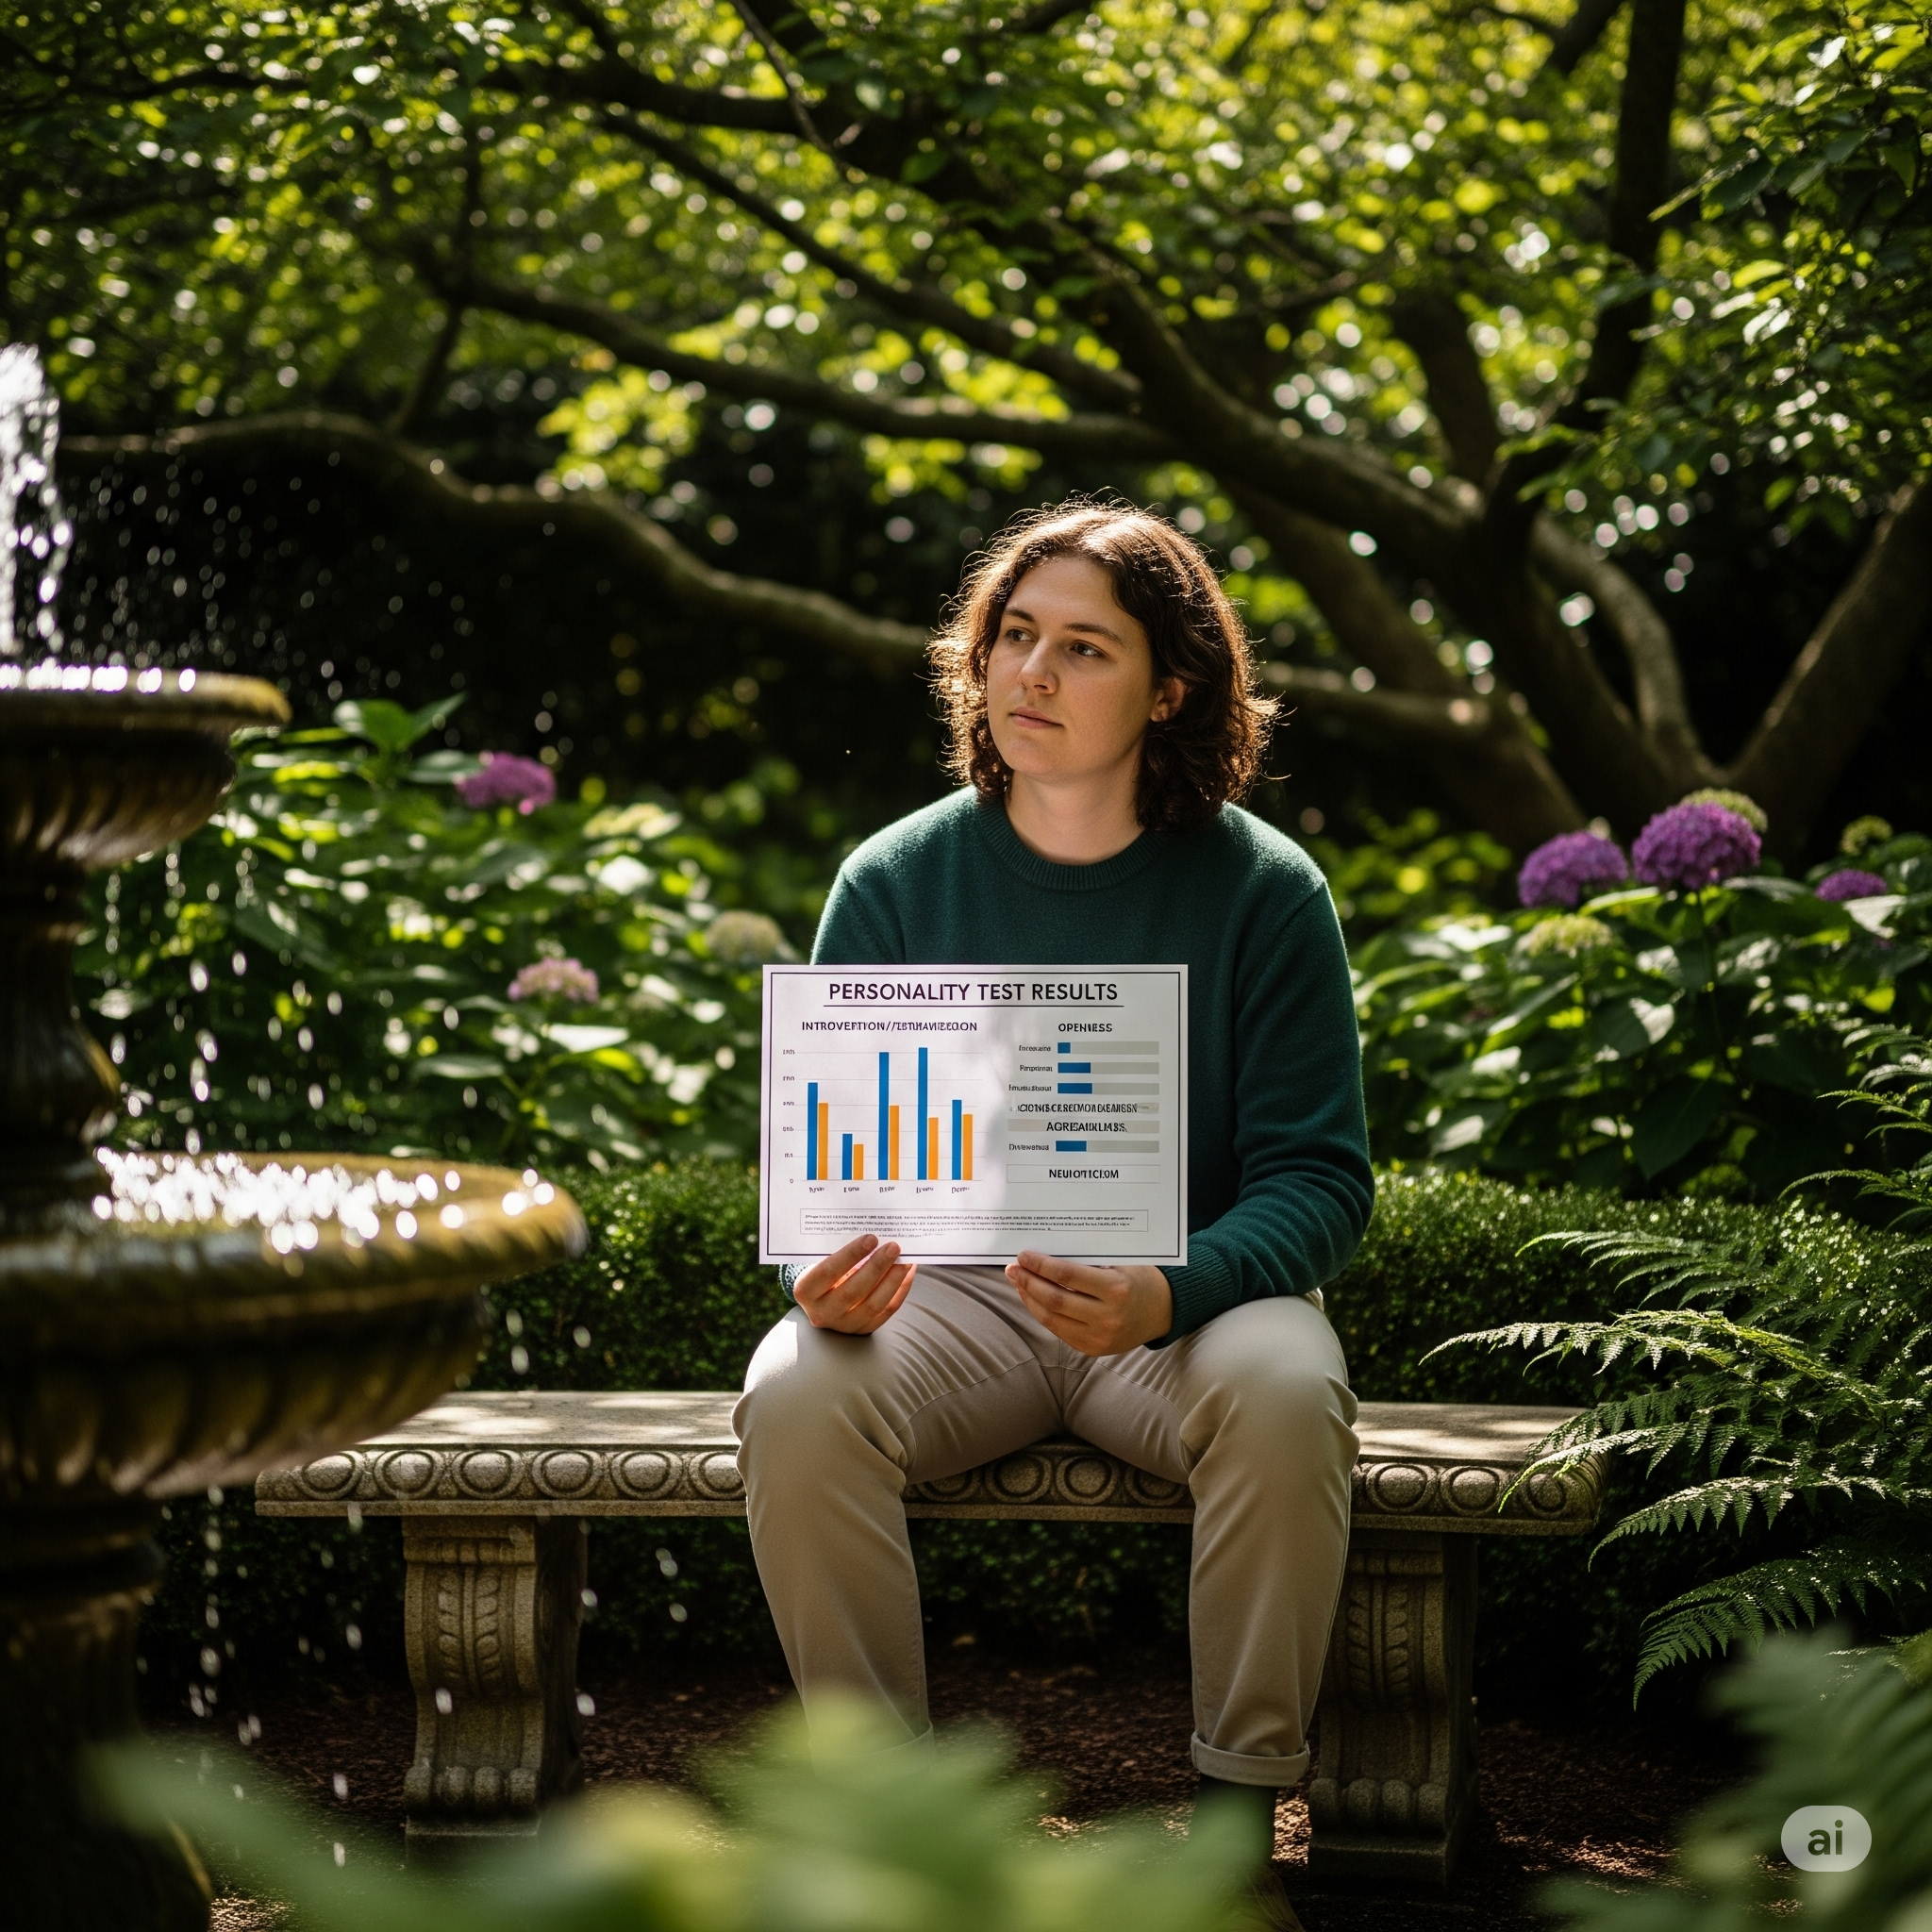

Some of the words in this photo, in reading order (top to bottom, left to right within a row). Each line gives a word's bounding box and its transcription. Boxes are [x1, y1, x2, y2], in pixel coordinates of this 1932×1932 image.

[829, 983, 970, 1001] PERSONALITY
[977, 983, 1025, 1001] TEST
[1032, 983, 1118, 1001] RESULTS
